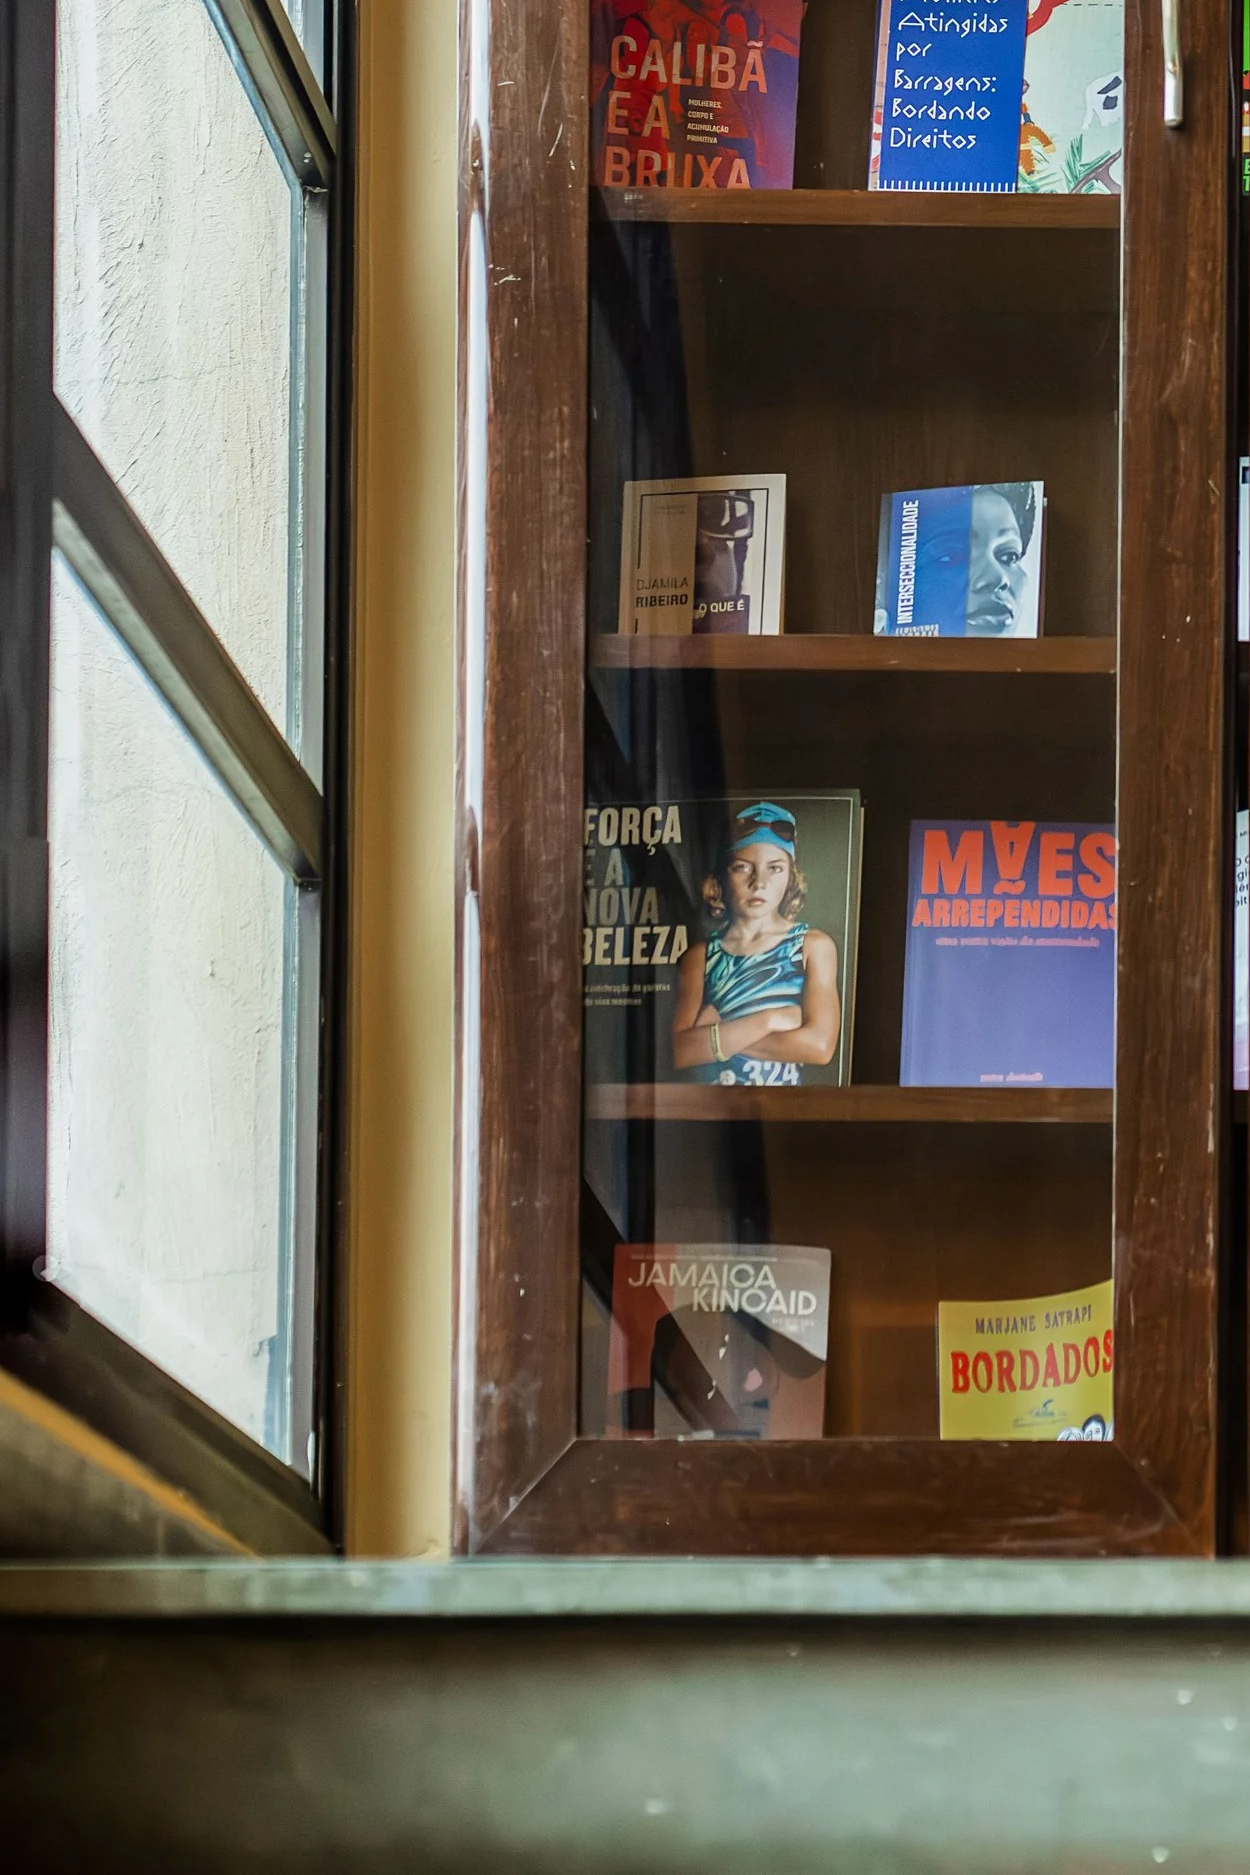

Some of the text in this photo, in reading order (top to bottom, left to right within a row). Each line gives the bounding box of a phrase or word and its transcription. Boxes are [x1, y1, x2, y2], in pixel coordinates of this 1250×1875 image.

[898, 11, 1008, 37] Atingidas
[610, 35, 767, 93] CALIBÃ
[896, 41, 932, 61] por
[894, 69, 997, 95] Barragens:
[607, 90, 670, 140] E A
[892, 99, 991, 121] Bordando
[890, 127, 977, 149] Direitos
[604, 146, 751, 188] BRUXA
[897, 500, 919, 624] INTERSECCIONALIDADE
[636, 577, 689, 591] DJAMILA
[635, 594, 688, 608] RIBEIRO
[699, 599, 744, 613] O QUE É
[584, 805, 682, 855] FORÇA
[584, 887, 659, 926] NOVA
[628, 1262, 776, 1288] JAMAICA
[693, 1288, 817, 1315] KINCAID
[975, 1304, 1092, 1334] MARJANE SATRAPI
[951, 1329, 1113, 1393] BORDADOS
